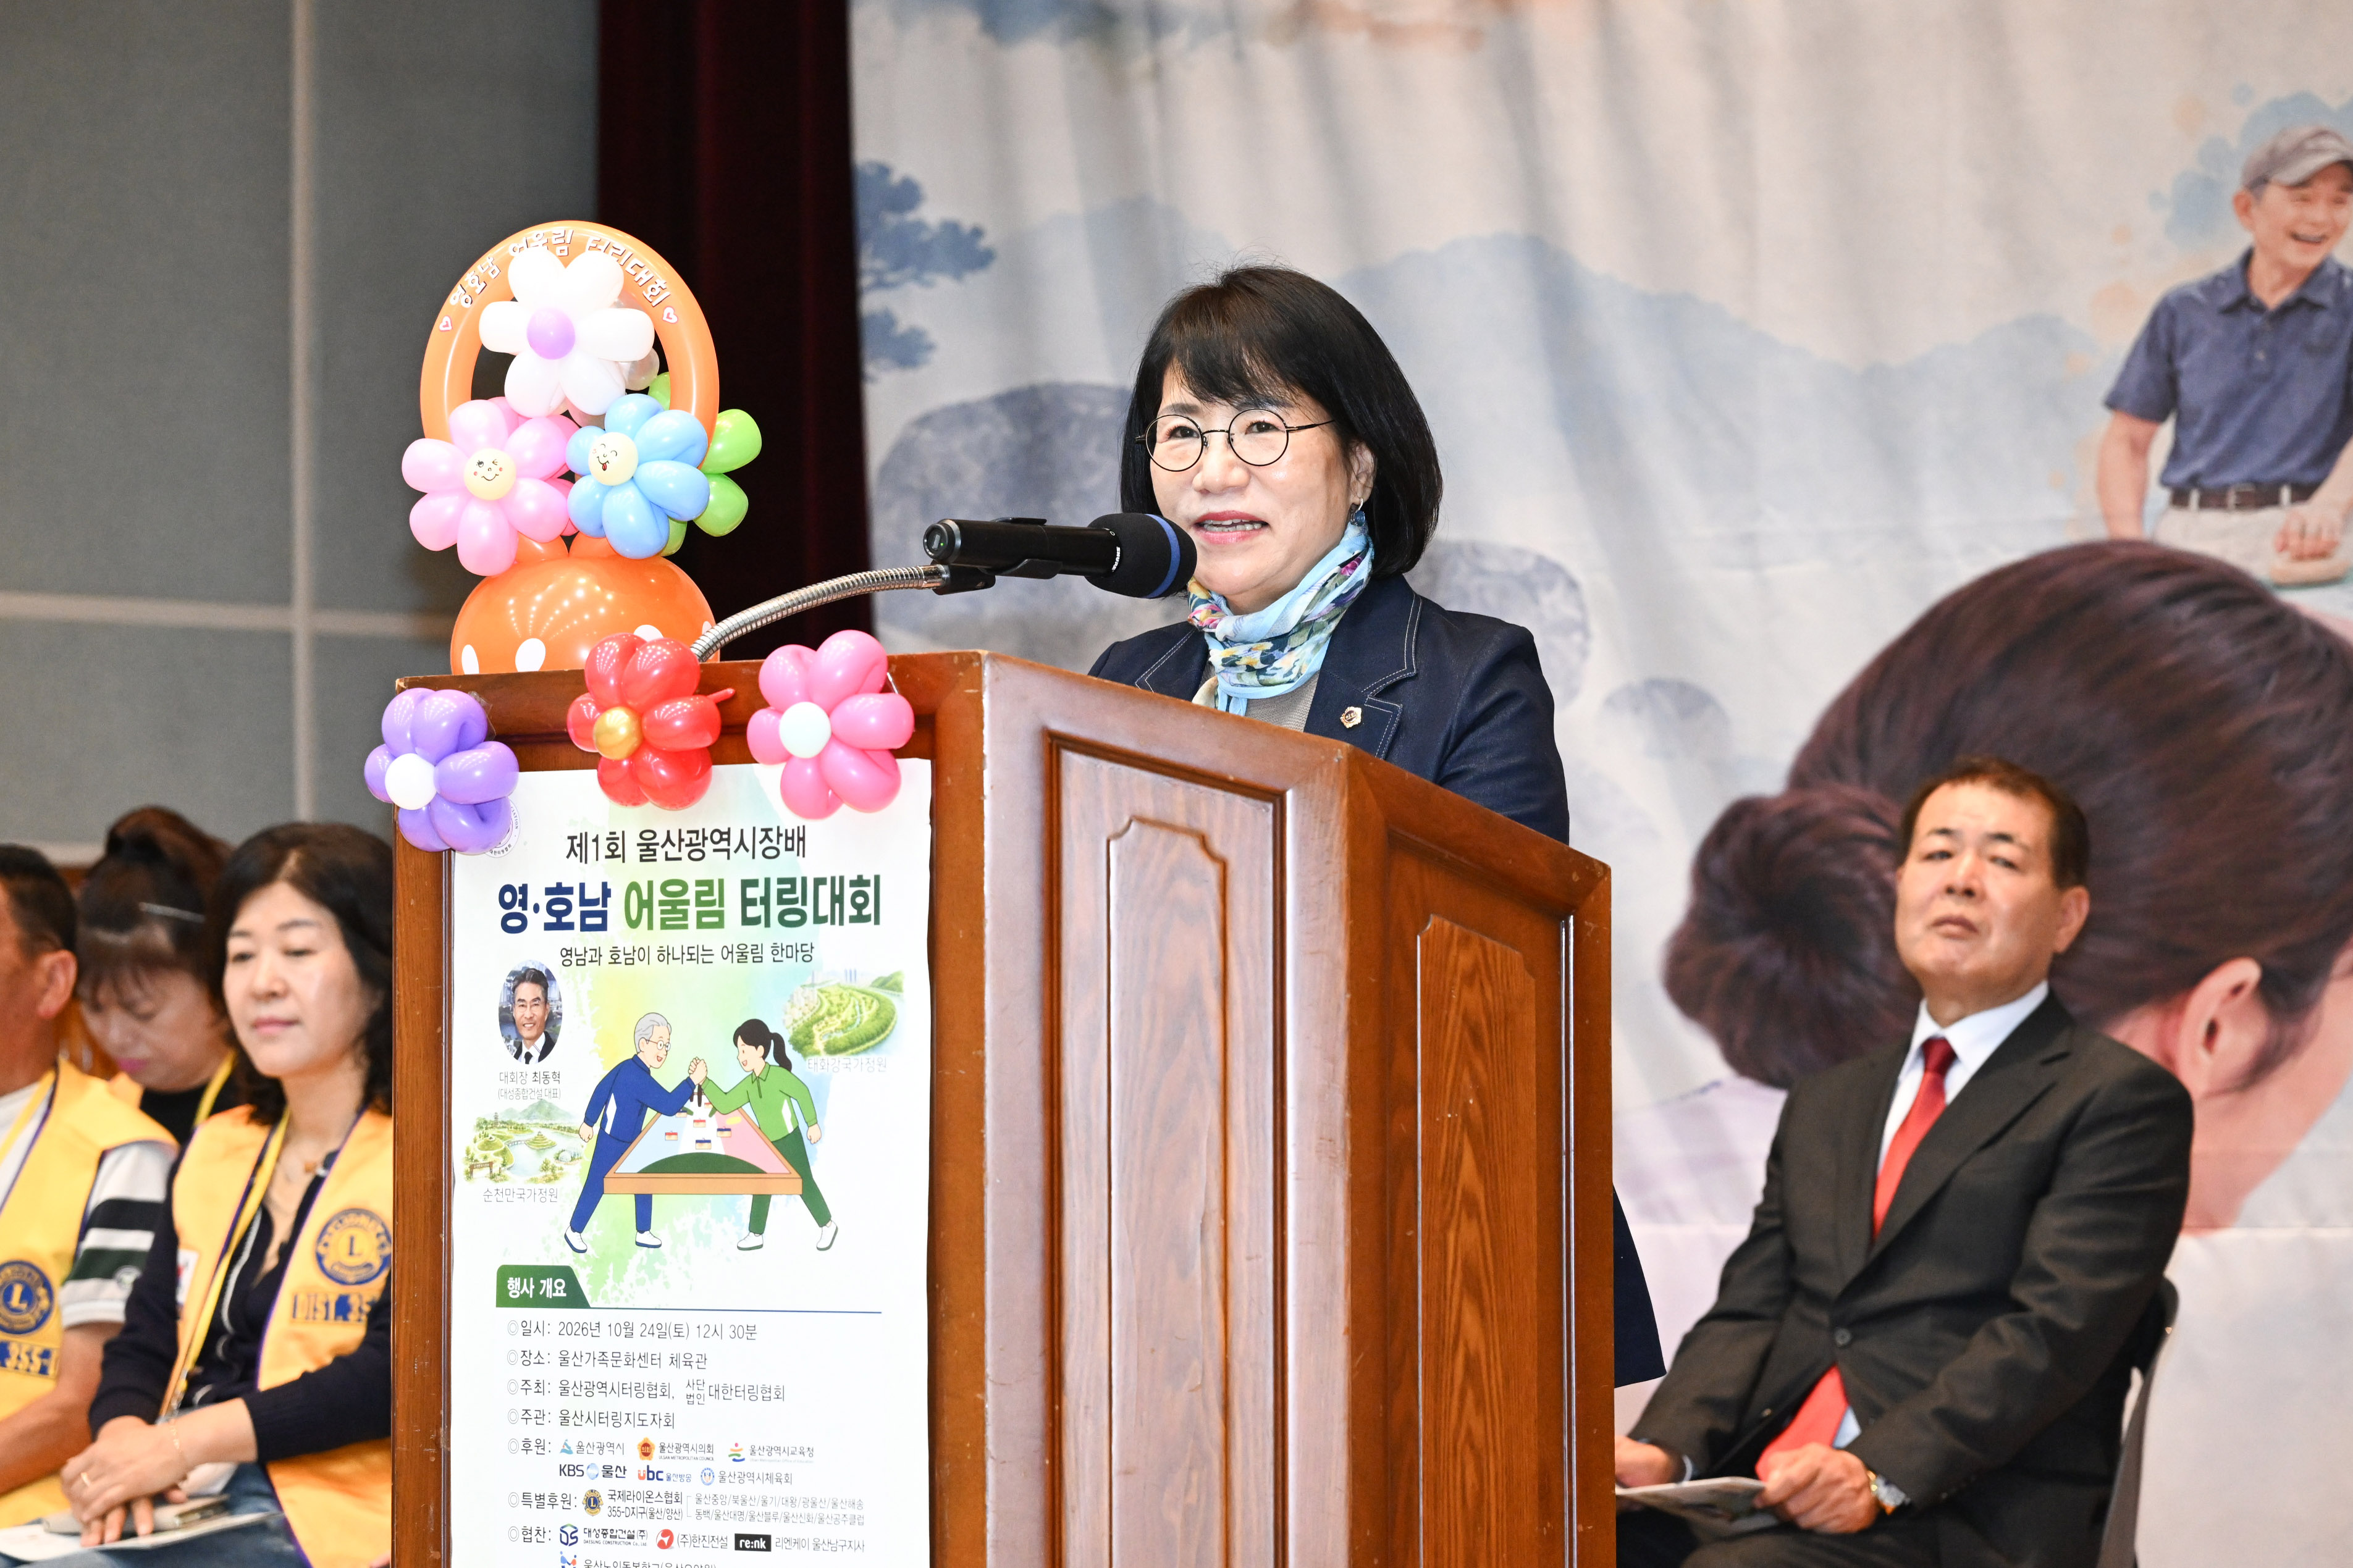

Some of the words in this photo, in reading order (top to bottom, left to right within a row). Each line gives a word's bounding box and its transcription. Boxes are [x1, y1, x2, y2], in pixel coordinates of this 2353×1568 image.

[449, 256, 502, 308] 영호남
[565, 830, 626, 865] 제1회
[636, 824, 806, 863] 울산광역시장배
[624, 878, 725, 931] 어울림
[740, 874, 881, 929] 터링대회
[560, 945, 603, 967] 영남과
[608, 945, 650, 966] 호남이
[657, 944, 715, 965] 하나되는
[721, 942, 764, 964] 어울림
[770, 942, 815, 963] 한마당
[808, 1057, 887, 1073] 태화강국가정원
[499, 1071, 528, 1085] 대회장
[532, 1070, 560, 1085] 최동혁
[497, 1086, 544, 1101] (대성종합건설
[544, 1086, 562, 1101] 대표)
[482, 1188, 558, 1203] 순천만국가정원
[507, 1277, 535, 1299] 행사
[539, 1277, 567, 1299] 개요
[558, 1321, 600, 1338] 2026년
[608, 1321, 634, 1338] 10월
[640, 1322, 689, 1340] 24일(토)
[696, 1323, 723, 1340] 12시
[729, 1323, 757, 1341] 30분
[558, 1349, 661, 1369] 울산가족문화센터
[668, 1352, 708, 1370] 체육관
[558, 1379, 675, 1399] 울산광역시터링협회,
[709, 1383, 785, 1402] 대한터링협회
[686, 1378, 705, 1391] 사단
[686, 1393, 705, 1405] 법인
[558, 1409, 675, 1430] 울산시터링지도자회
[575, 1440, 625, 1456] 울산광역시
[659, 1442, 713, 1455] 울산광역시의회
[749, 1444, 814, 1458] 울산광역시교육청
[559, 1464, 584, 1477] KBS
[601, 1464, 628, 1478] 울산
[638, 1464, 664, 1482] ubc
[665, 1472, 692, 1483] 울산방송
[718, 1470, 792, 1485] 울산광역시체육회
[521, 1492, 577, 1510] 특별후원:
[607, 1489, 683, 1505] 국제라이온스협회
[607, 1504, 684, 1522] 355-D지구(울산/양산)
[677, 1533, 728, 1549] (주)한진전설
[739, 1538, 766, 1549] re:nk
[775, 1537, 809, 1551] 리엔케이
[812, 1538, 865, 1553] 울산남구지사
